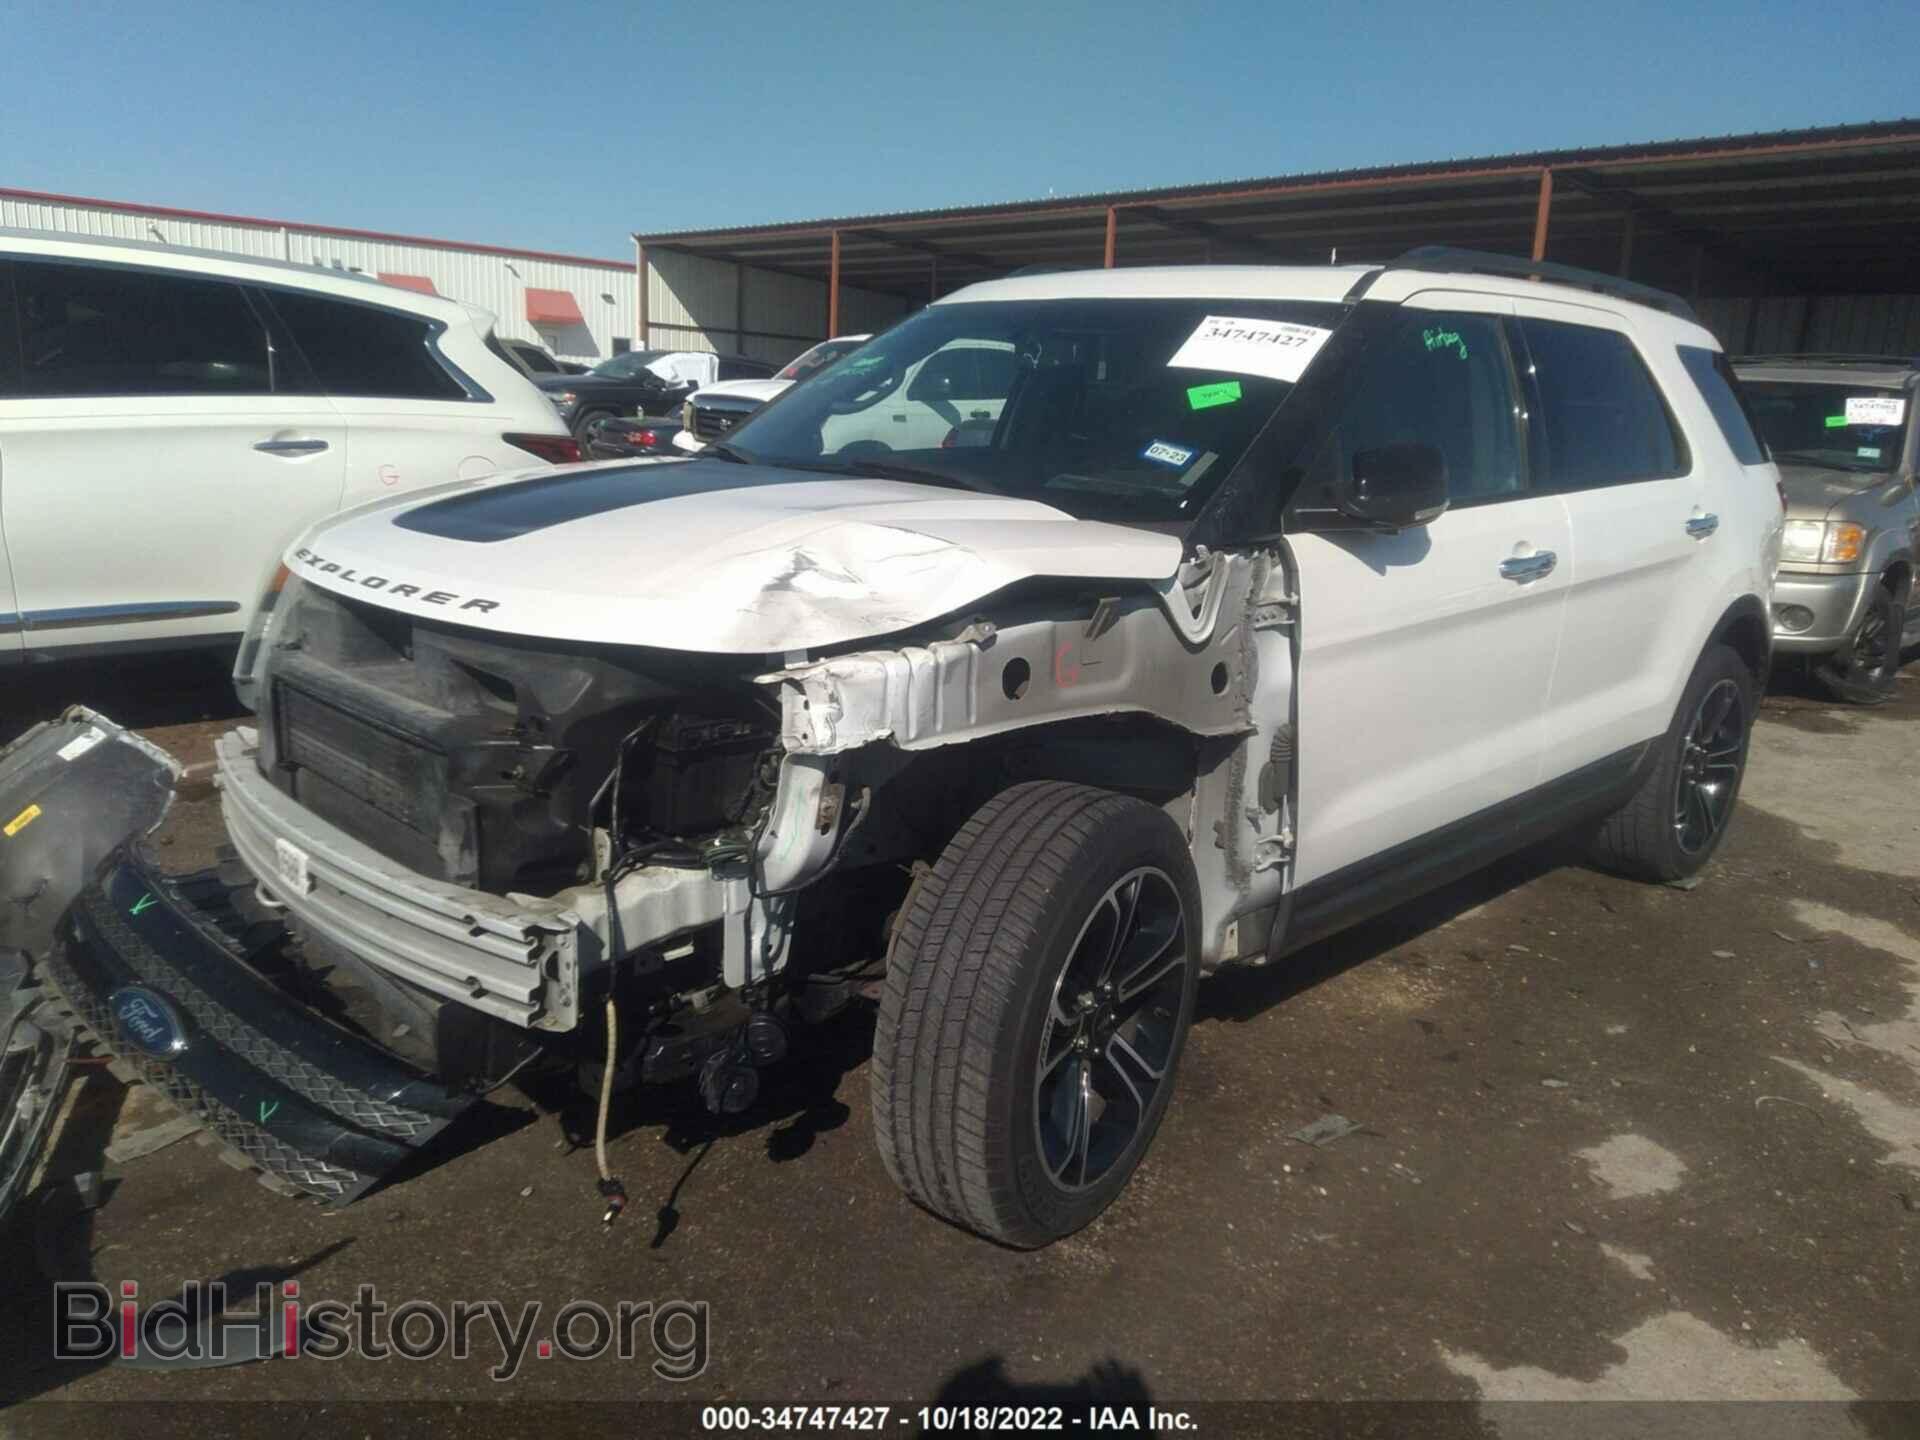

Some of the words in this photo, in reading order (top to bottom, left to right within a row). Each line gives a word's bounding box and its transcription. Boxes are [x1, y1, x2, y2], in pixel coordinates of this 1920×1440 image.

[1204, 326, 1309, 348] 34747427
[295, 548, 501, 614] EXPLORER
[118, 998, 165, 1043] Ford
